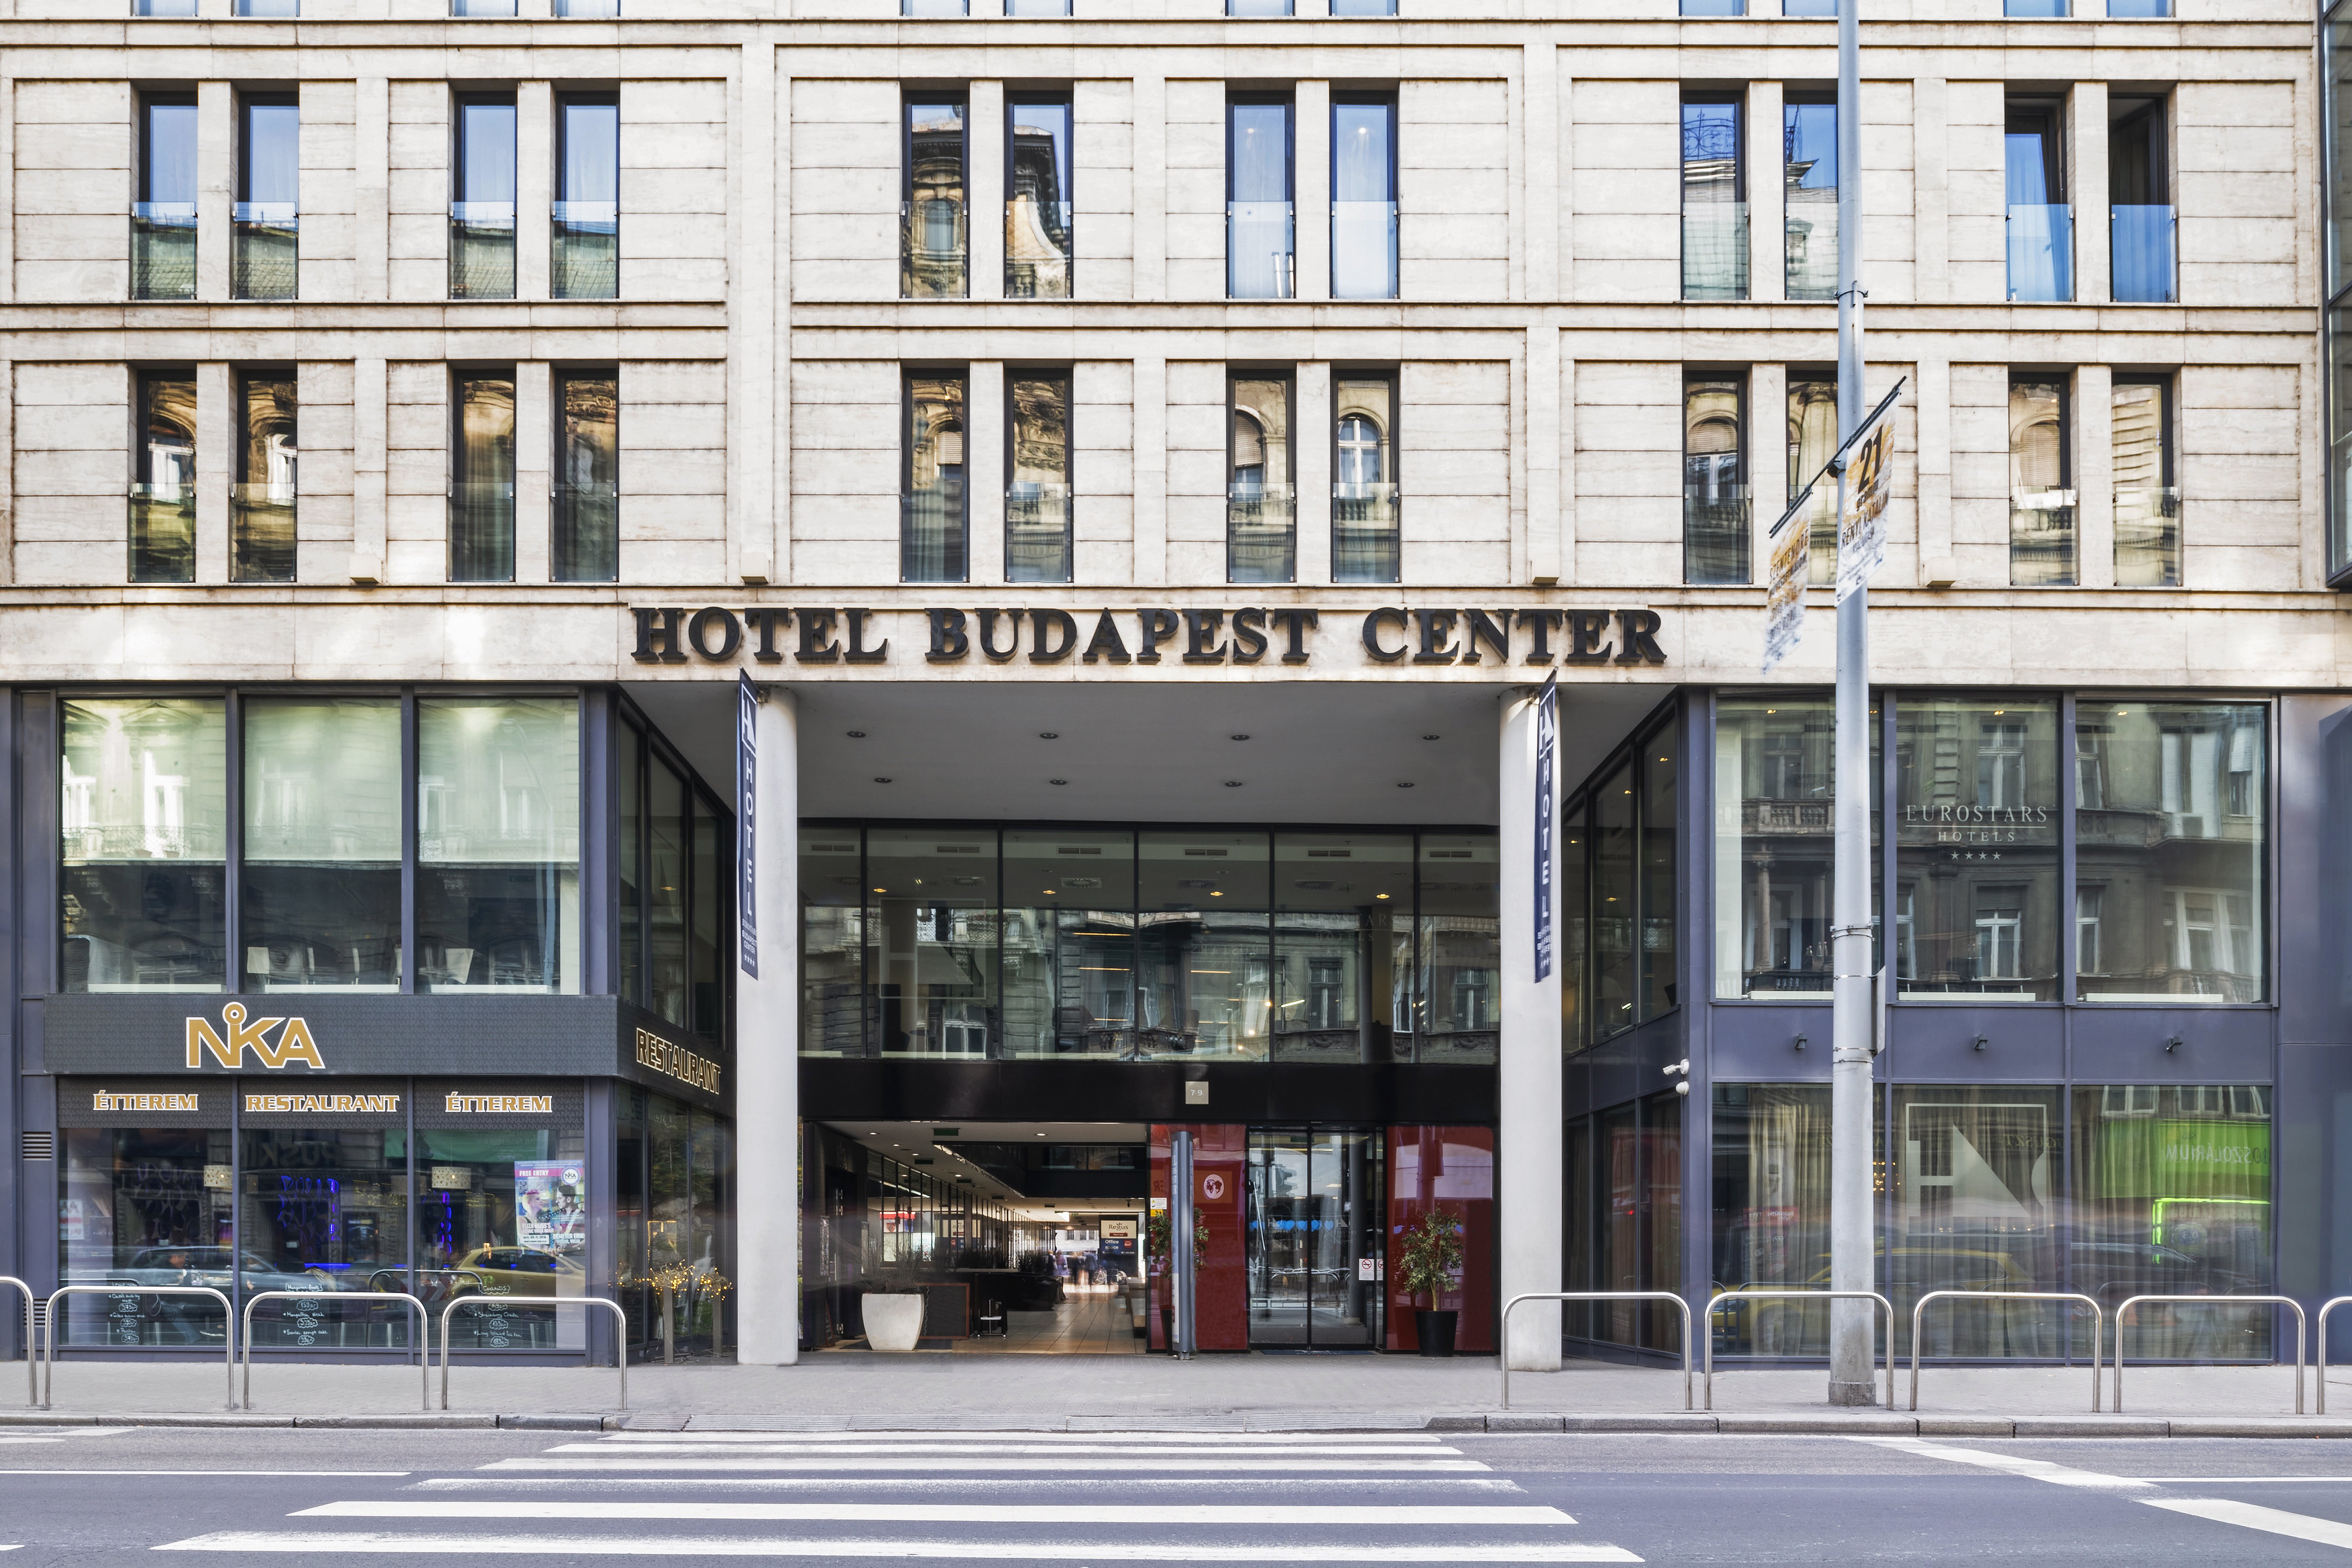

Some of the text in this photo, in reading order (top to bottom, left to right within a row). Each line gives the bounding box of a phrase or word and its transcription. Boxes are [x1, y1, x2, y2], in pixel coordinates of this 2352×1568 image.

[1857, 424, 1883, 494] 21
[1856, 478, 1879, 512] gramm
[630, 607, 1668, 665] HOTEL BUDAPEST CENTER
[1906, 805, 2047, 823] EUROSTARS
[745, 756, 754, 917] HOTEL
[1542, 759, 1551, 918] HOTEL
[1938, 831, 2015, 842] HOTELS
[635, 1026, 721, 1095] RESTAURANT
[93, 1089, 199, 1111] ÉTTEREM
[245, 1094, 400, 1113] RESTAURANT
[445, 1091, 553, 1113] ÉTTEREM
